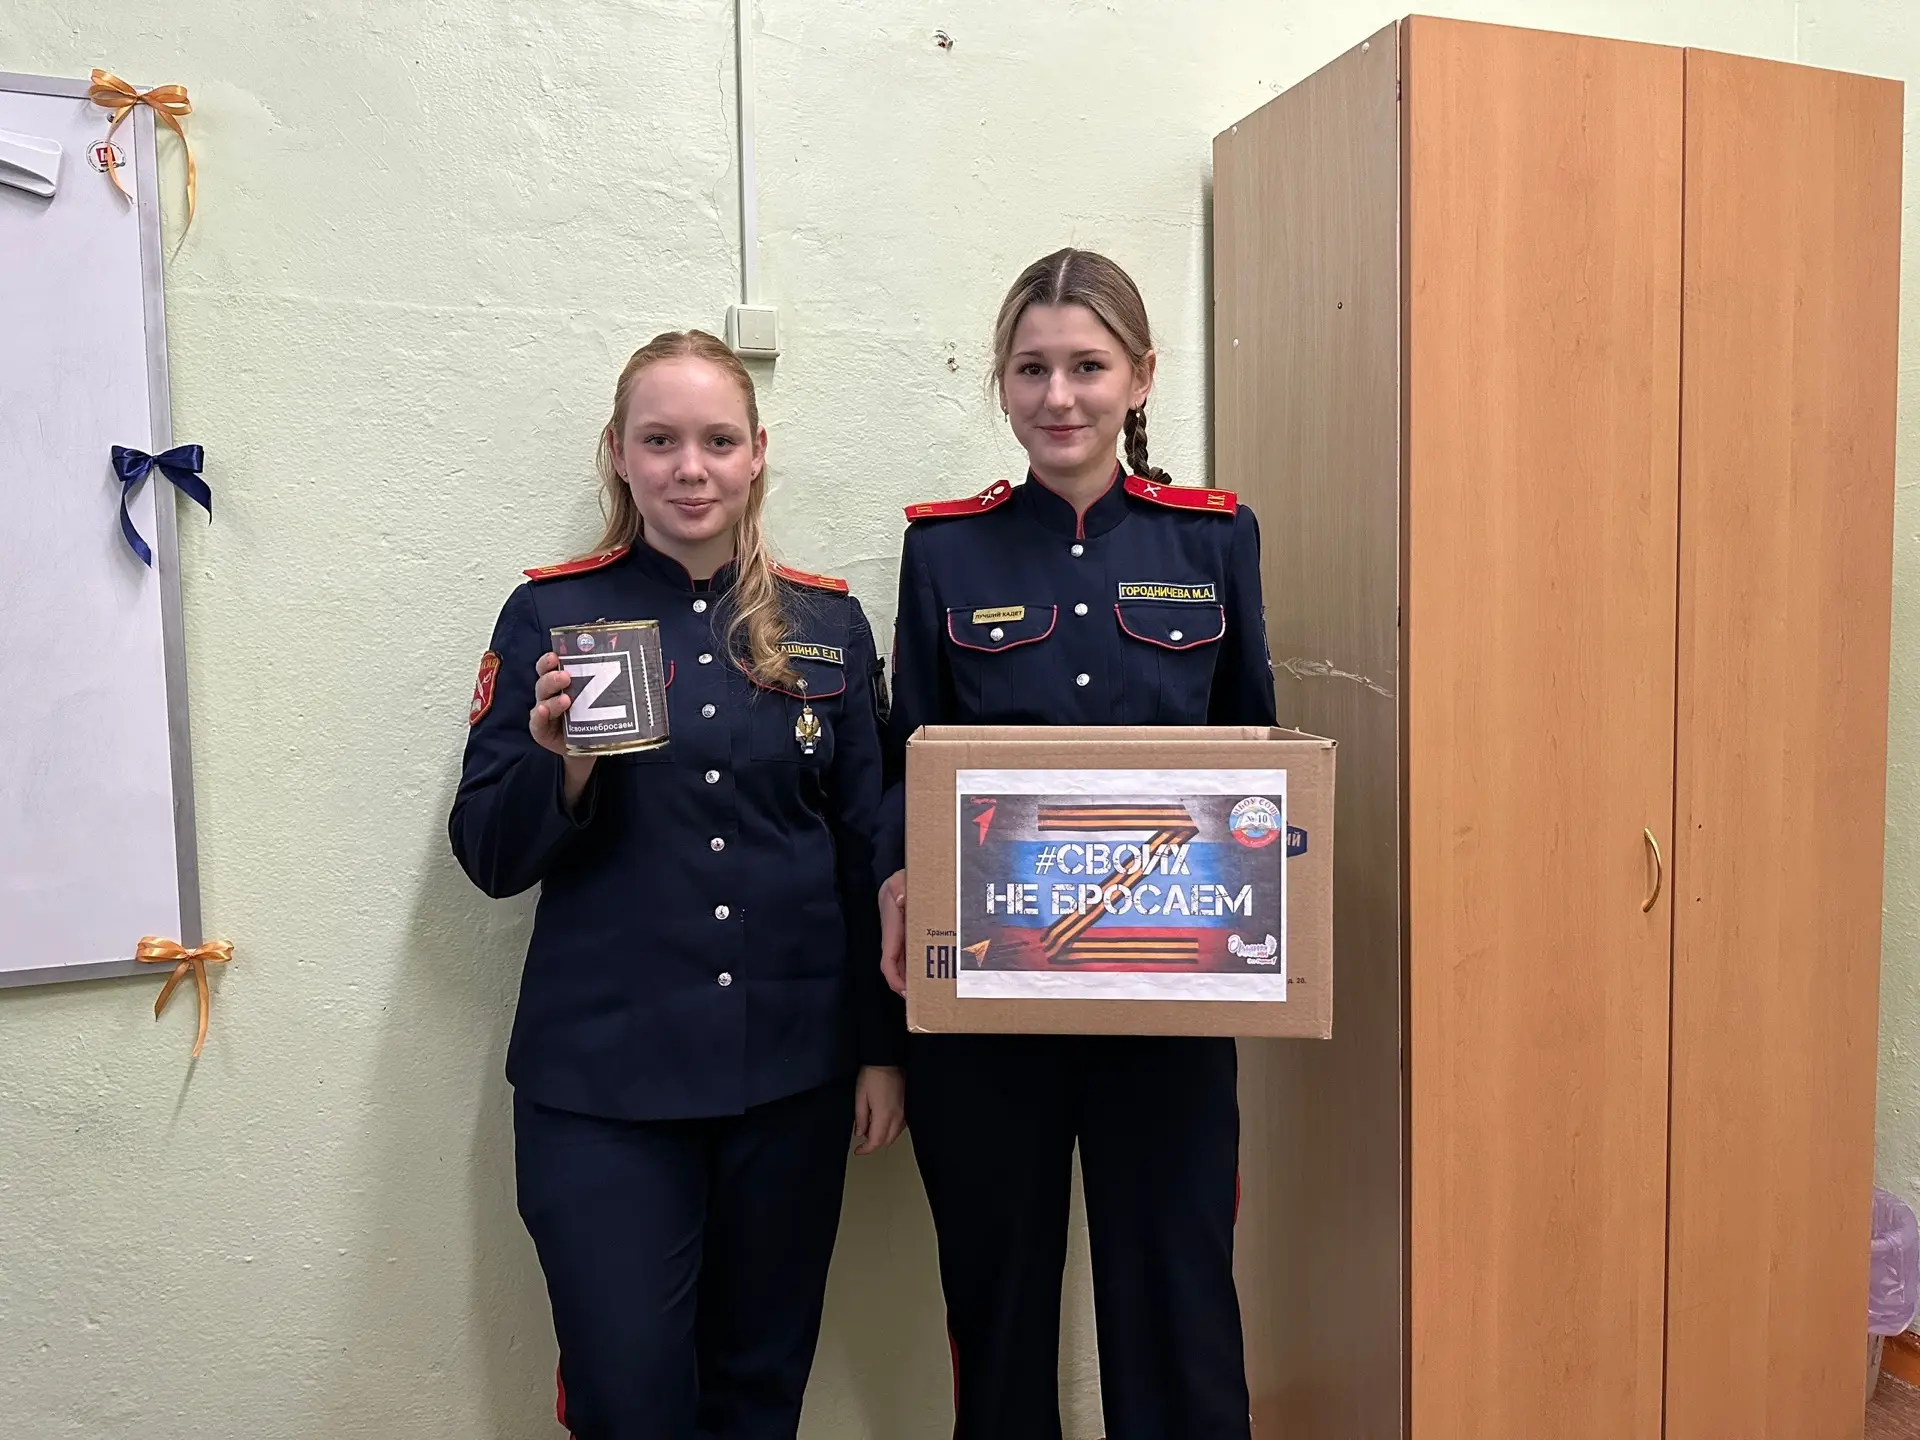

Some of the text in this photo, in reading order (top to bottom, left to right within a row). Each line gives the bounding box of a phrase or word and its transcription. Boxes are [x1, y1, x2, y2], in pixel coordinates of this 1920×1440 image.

[1121, 586, 1214, 599] ГОРОДНИЧЕВА М.А.
[563, 660, 628, 722] Z
[1257, 814, 1268, 823] 10
[1035, 843, 1192, 876] #СВОИХ
[986, 882, 1253, 917] НЕ БРОСАЕМ
